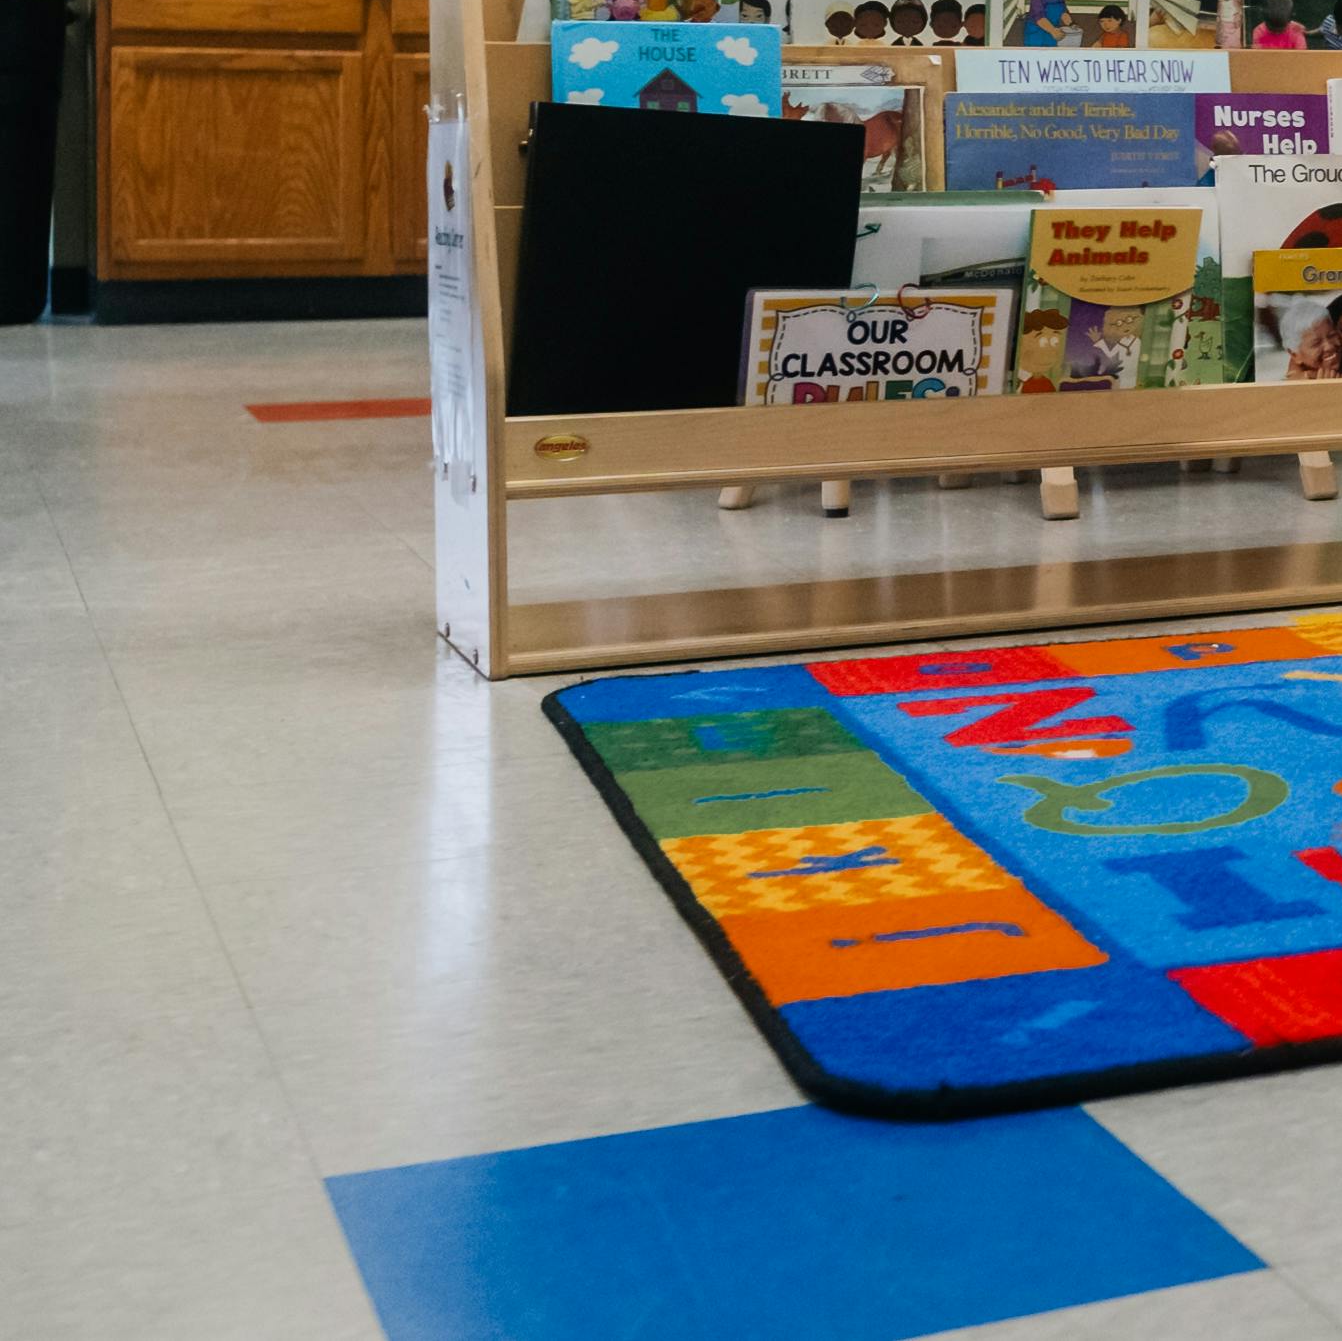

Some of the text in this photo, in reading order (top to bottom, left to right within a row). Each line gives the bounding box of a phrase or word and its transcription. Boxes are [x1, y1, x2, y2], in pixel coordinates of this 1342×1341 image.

[652, 28, 679, 43] THE
[639, 46, 696, 63] HOUSE
[999, 60, 1194, 84] TEN WAYS TO HEAR SNOW
[955, 101, 1077, 117] Alexander and the
[1214, 106, 1305, 127] Nurses
[1021, 125, 1040, 139] No
[1089, 125, 1119, 142] Very
[1125, 125, 1148, 139] Bad
[1152, 125, 1181, 142] Day
[1263, 134, 1317, 154] Help
[1249, 164, 1286, 183] The
[1052, 220, 1177, 243] They Help
[1049, 246, 1149, 266] Animals
[847, 319, 909, 344] OUR
[782, 350, 966, 378] CLASSROOM
